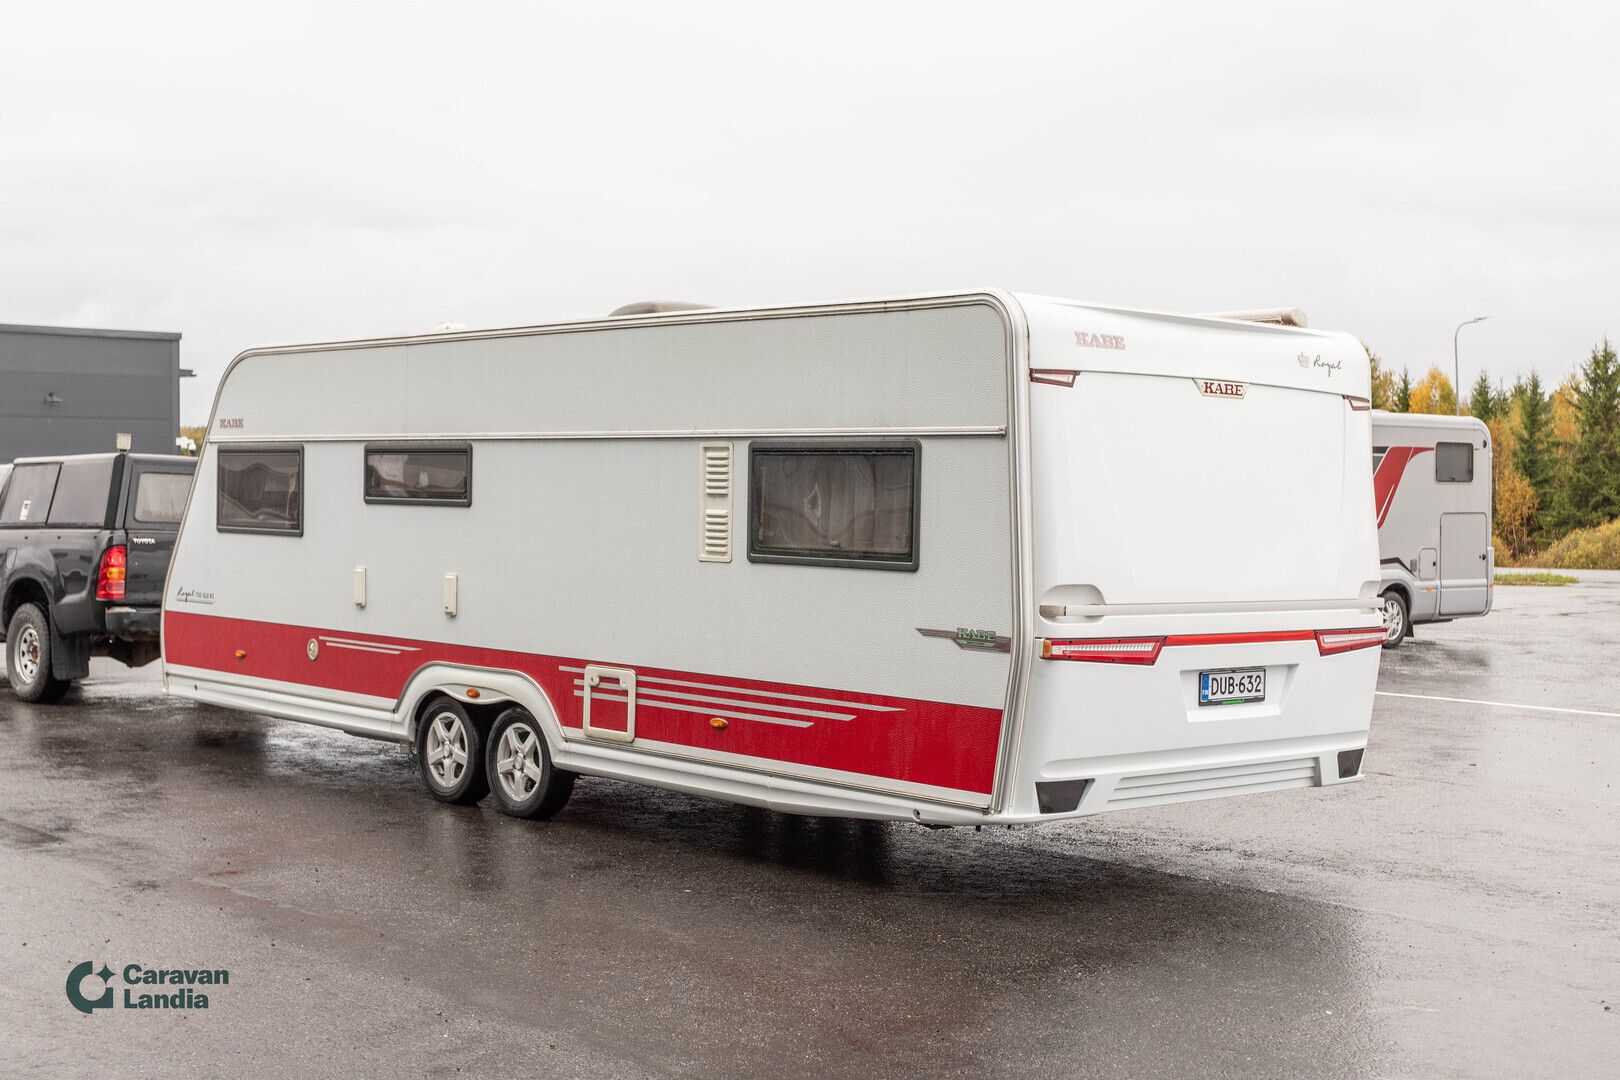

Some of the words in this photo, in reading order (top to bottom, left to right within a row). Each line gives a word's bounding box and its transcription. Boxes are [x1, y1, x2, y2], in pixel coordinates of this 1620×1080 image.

[1074, 331, 1126, 350] KABE
[1313, 354, 1341, 377] Royal
[1203, 381, 1243, 396] KABE
[957, 627, 996, 641] KABE
[1211, 675, 1262, 695] DUB-632
